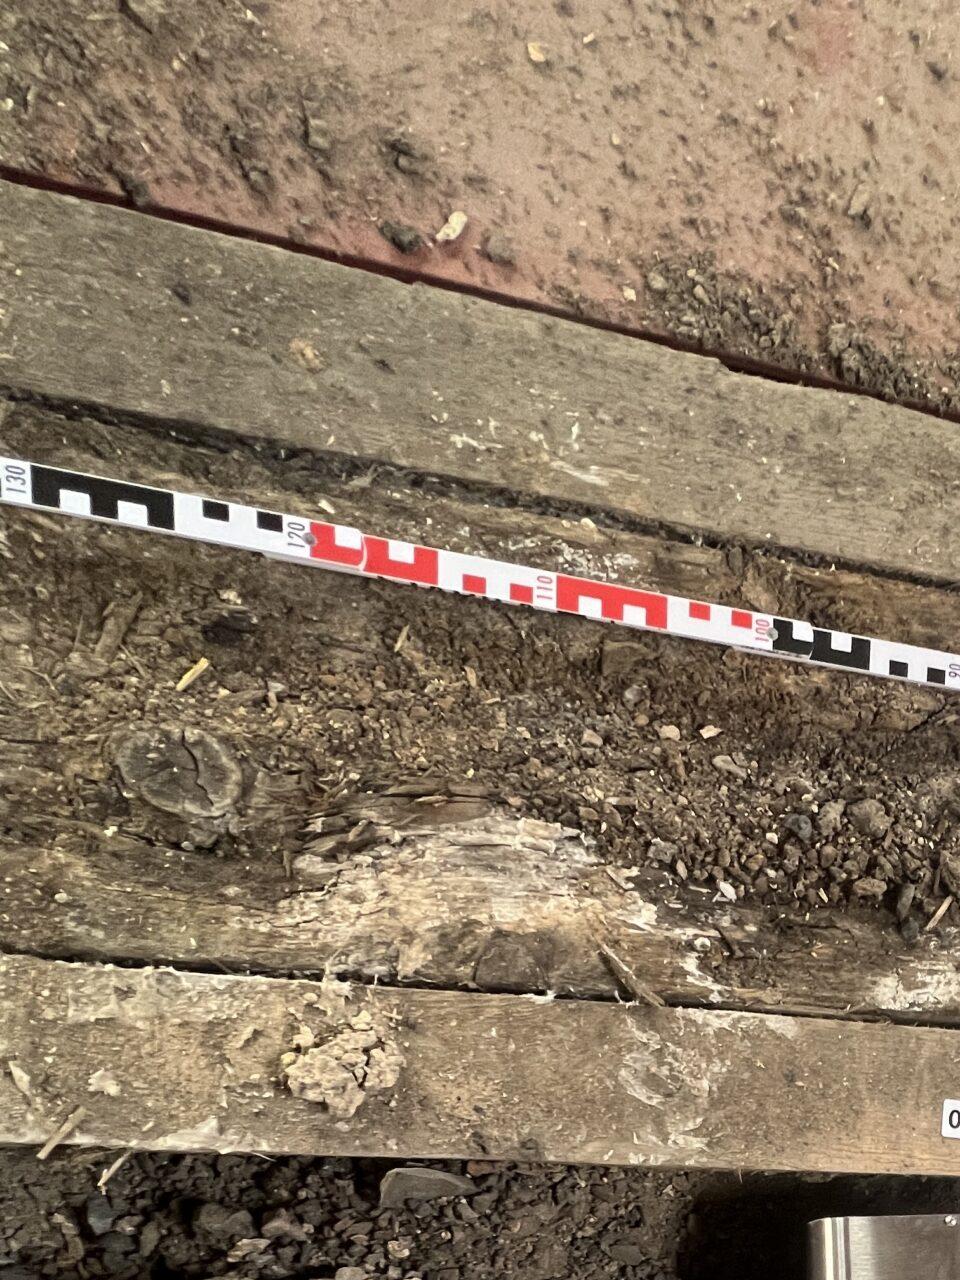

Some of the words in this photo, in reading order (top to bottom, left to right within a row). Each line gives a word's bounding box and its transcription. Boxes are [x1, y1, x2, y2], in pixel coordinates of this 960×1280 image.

[5, 465, 27, 494] 130
[287, 522, 305, 549] 120
[537, 576, 553, 600] 110
[755, 619, 770, 642] 100
